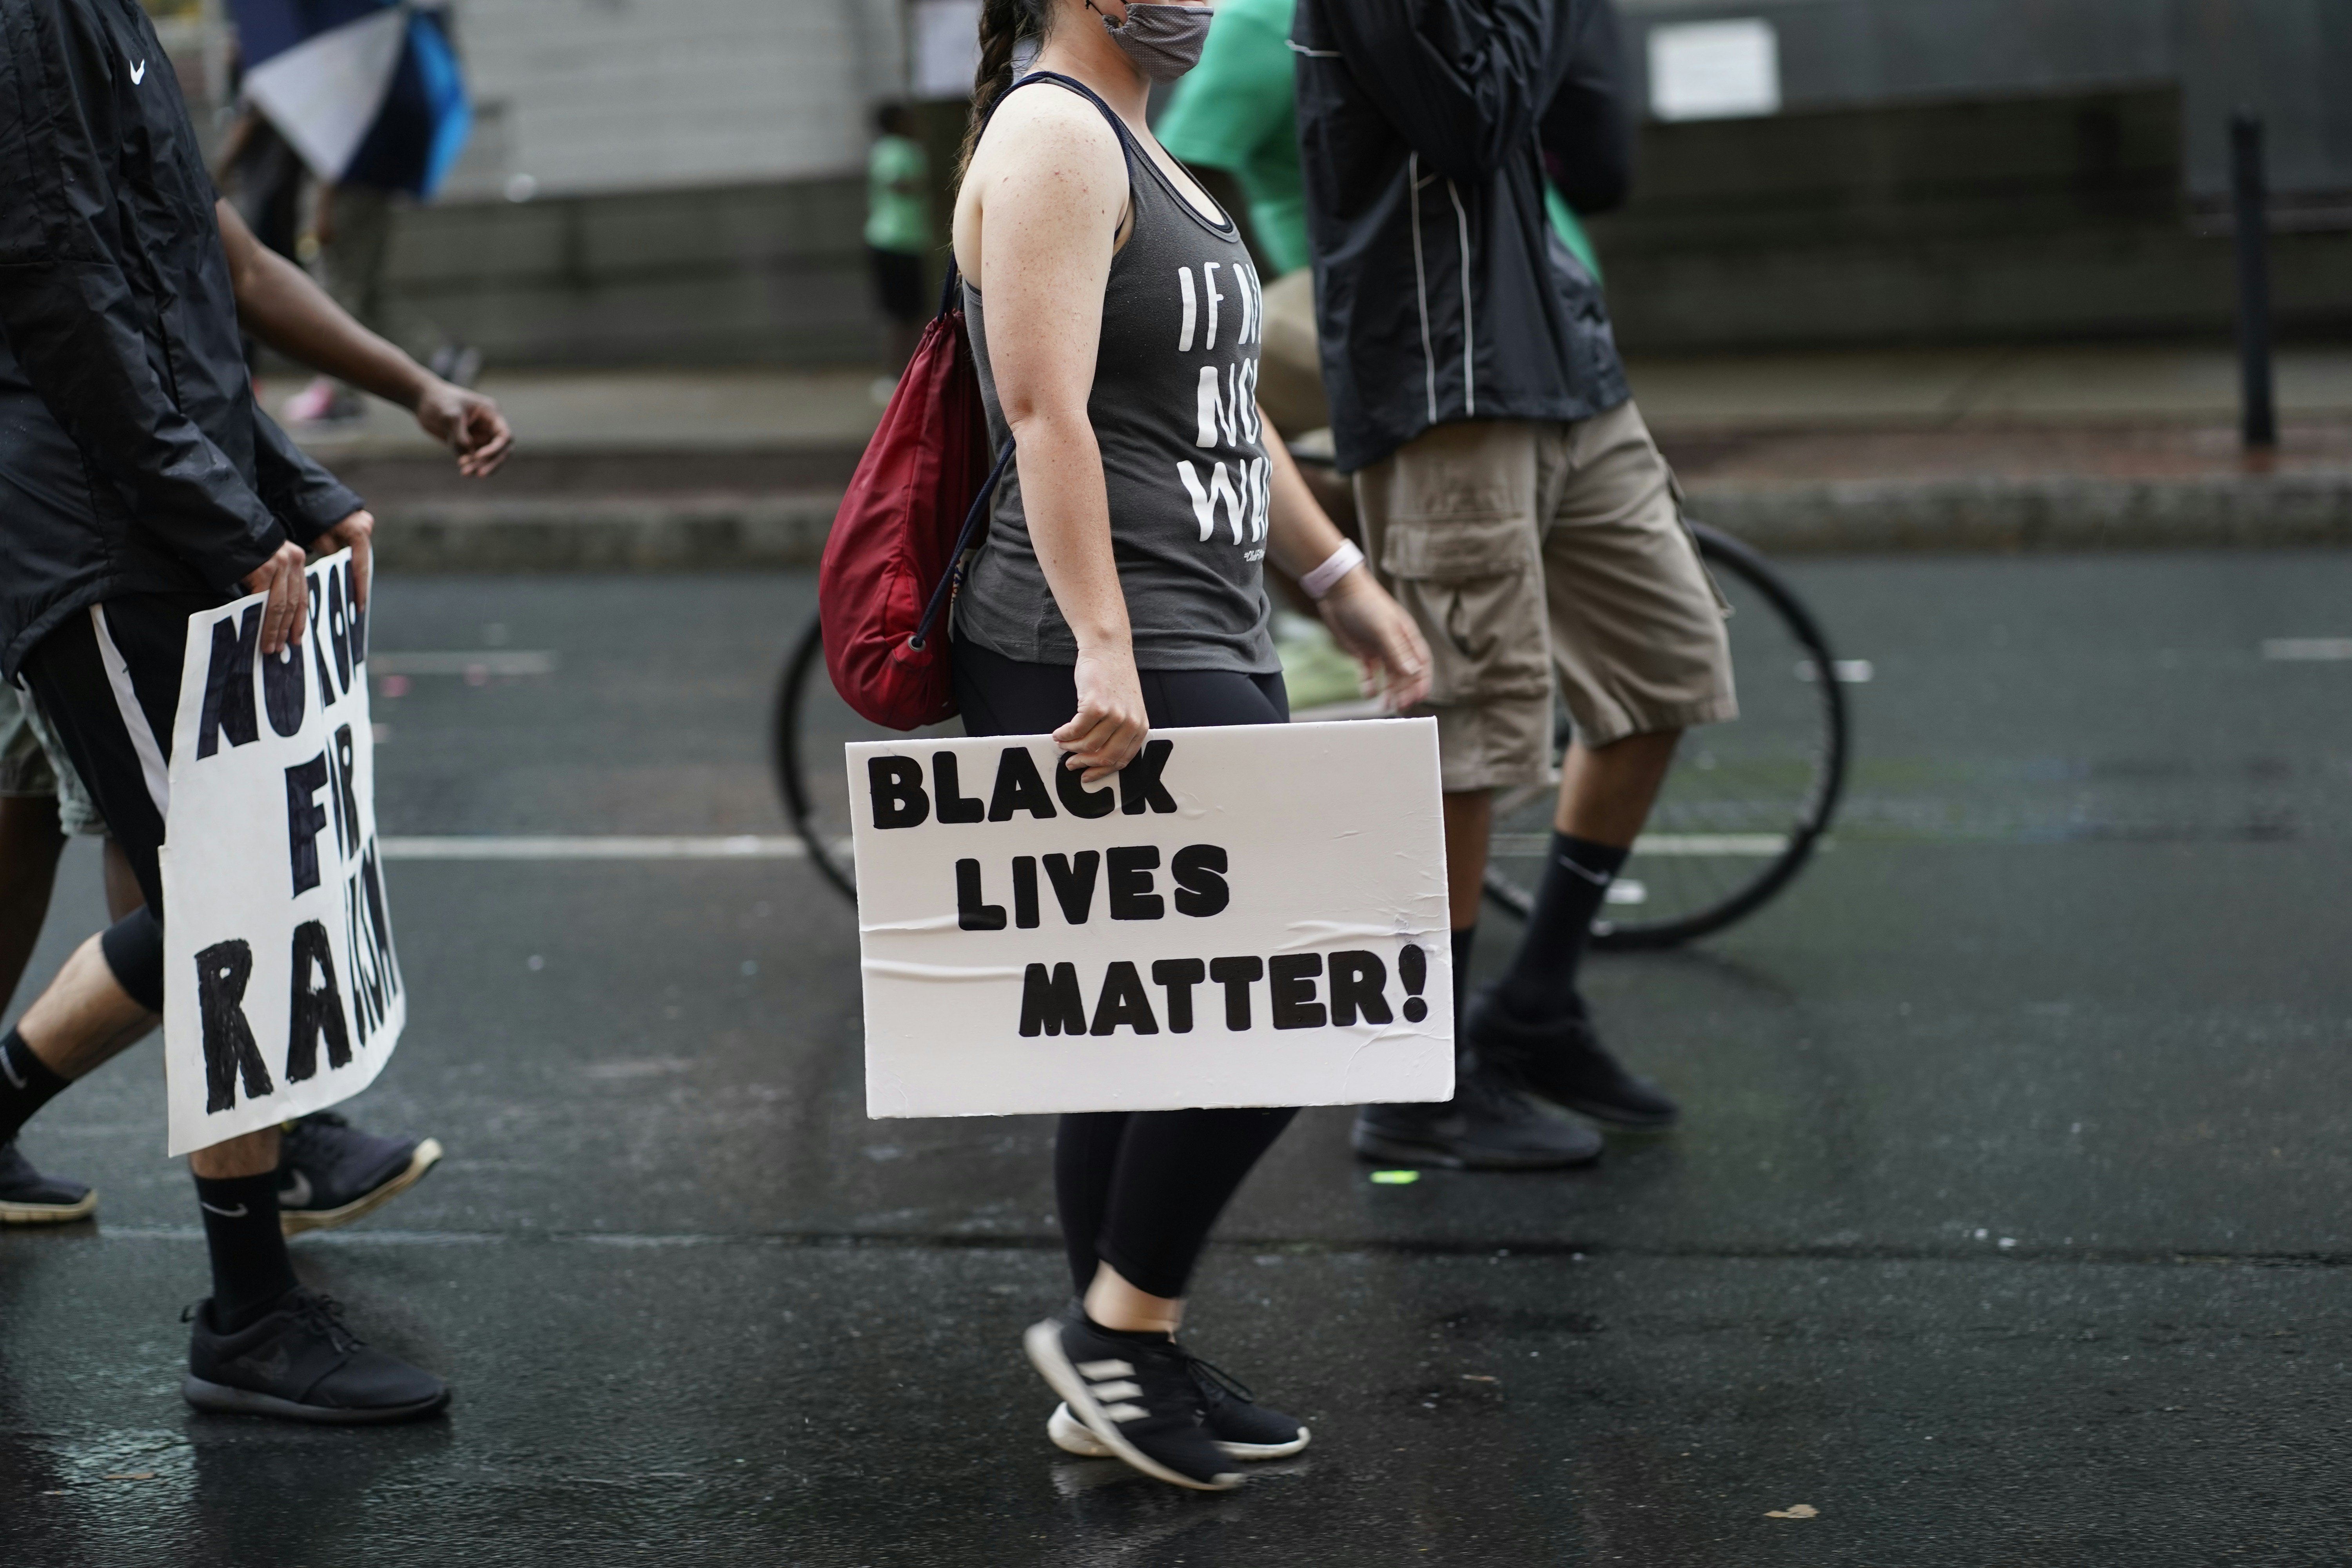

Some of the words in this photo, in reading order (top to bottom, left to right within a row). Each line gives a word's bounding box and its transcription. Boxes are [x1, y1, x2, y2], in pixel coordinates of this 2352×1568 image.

[1178, 262, 1224, 351] IF
[868, 740, 1177, 829] BLACK
[955, 844, 1229, 931] LIVES
[1019, 944, 1428, 1037] MATTER!
